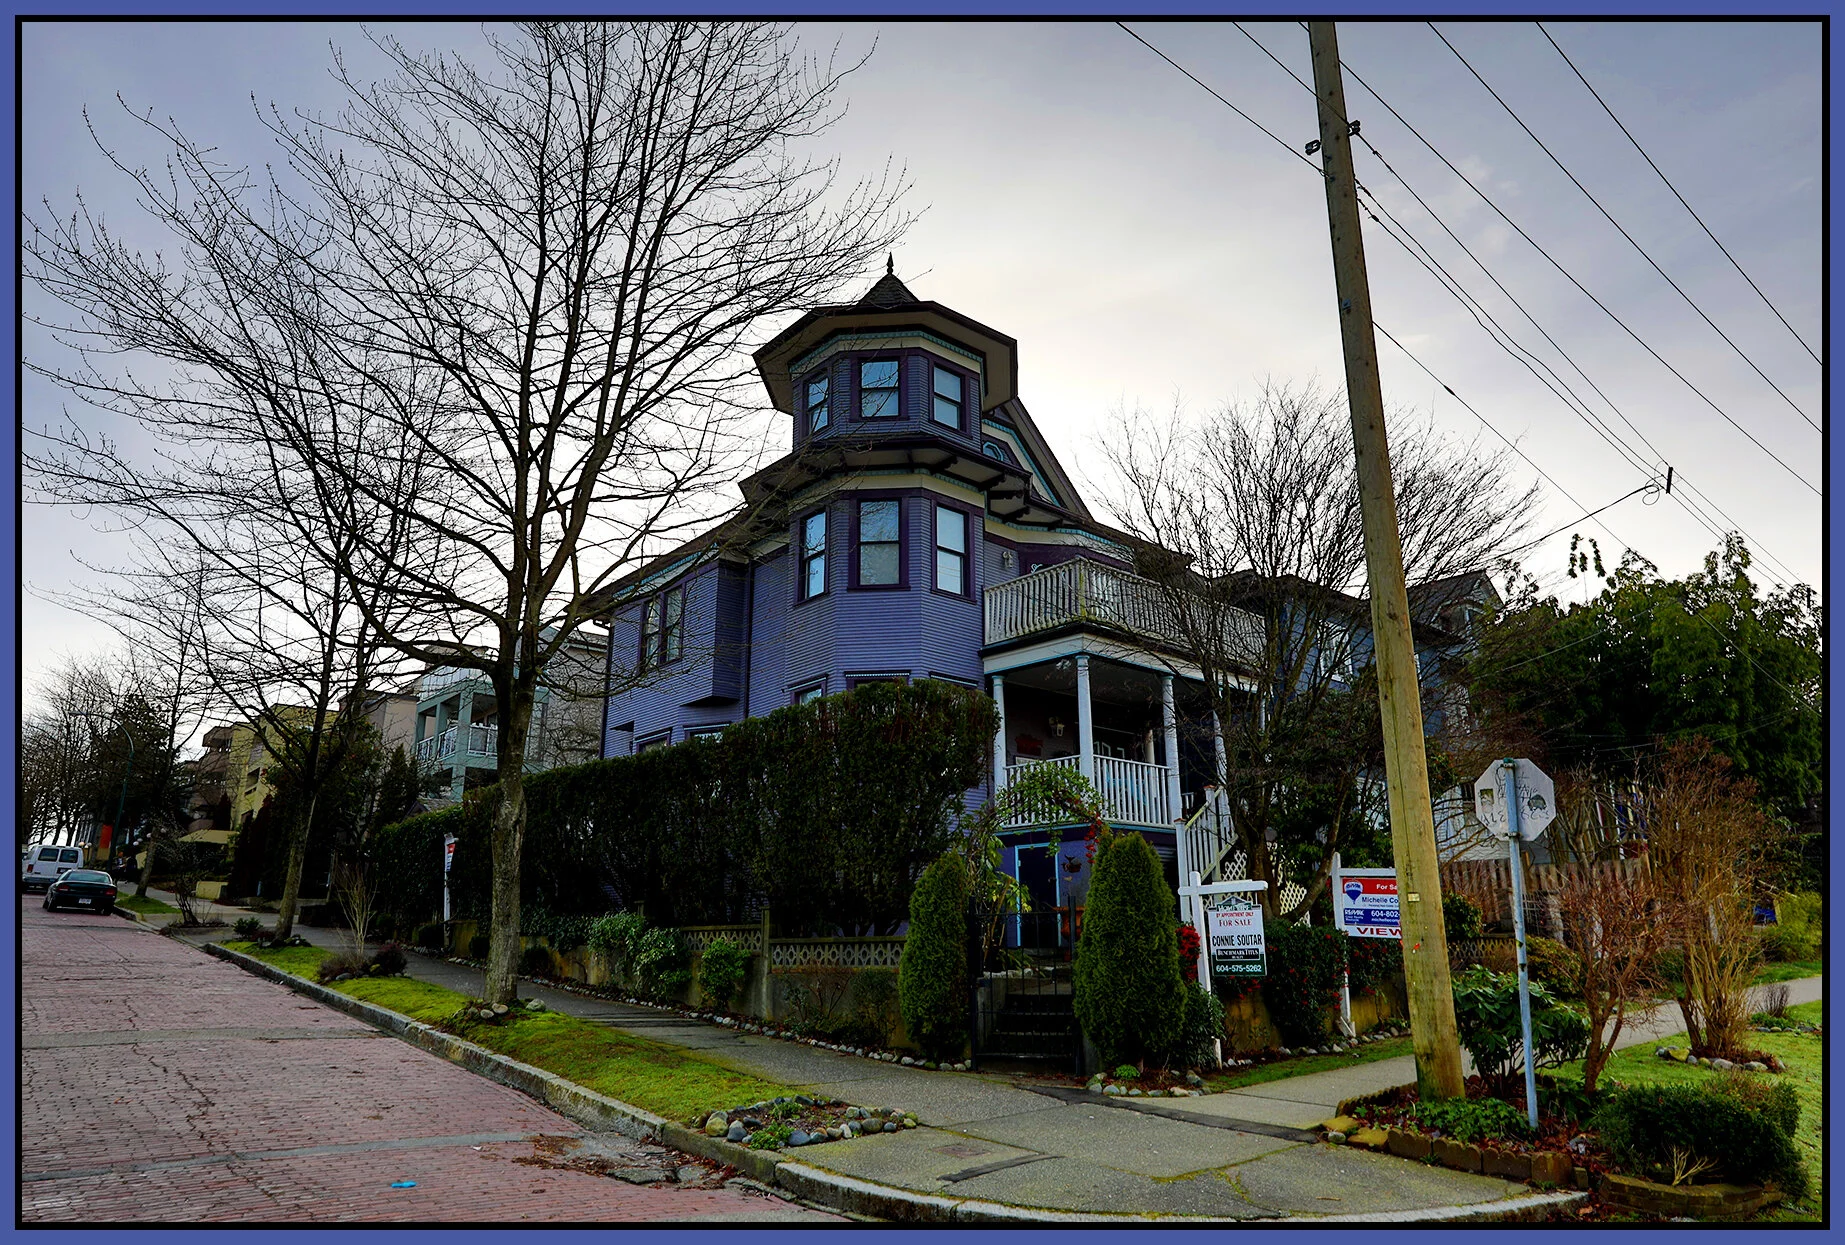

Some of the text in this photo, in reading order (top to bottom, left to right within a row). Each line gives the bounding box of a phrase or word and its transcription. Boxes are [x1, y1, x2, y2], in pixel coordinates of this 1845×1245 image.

[1219, 919, 1233, 927] FOR
[1212, 934, 1263, 946] CONNIE SOUTAR
[1216, 964, 1262, 972] 604-575-5262
